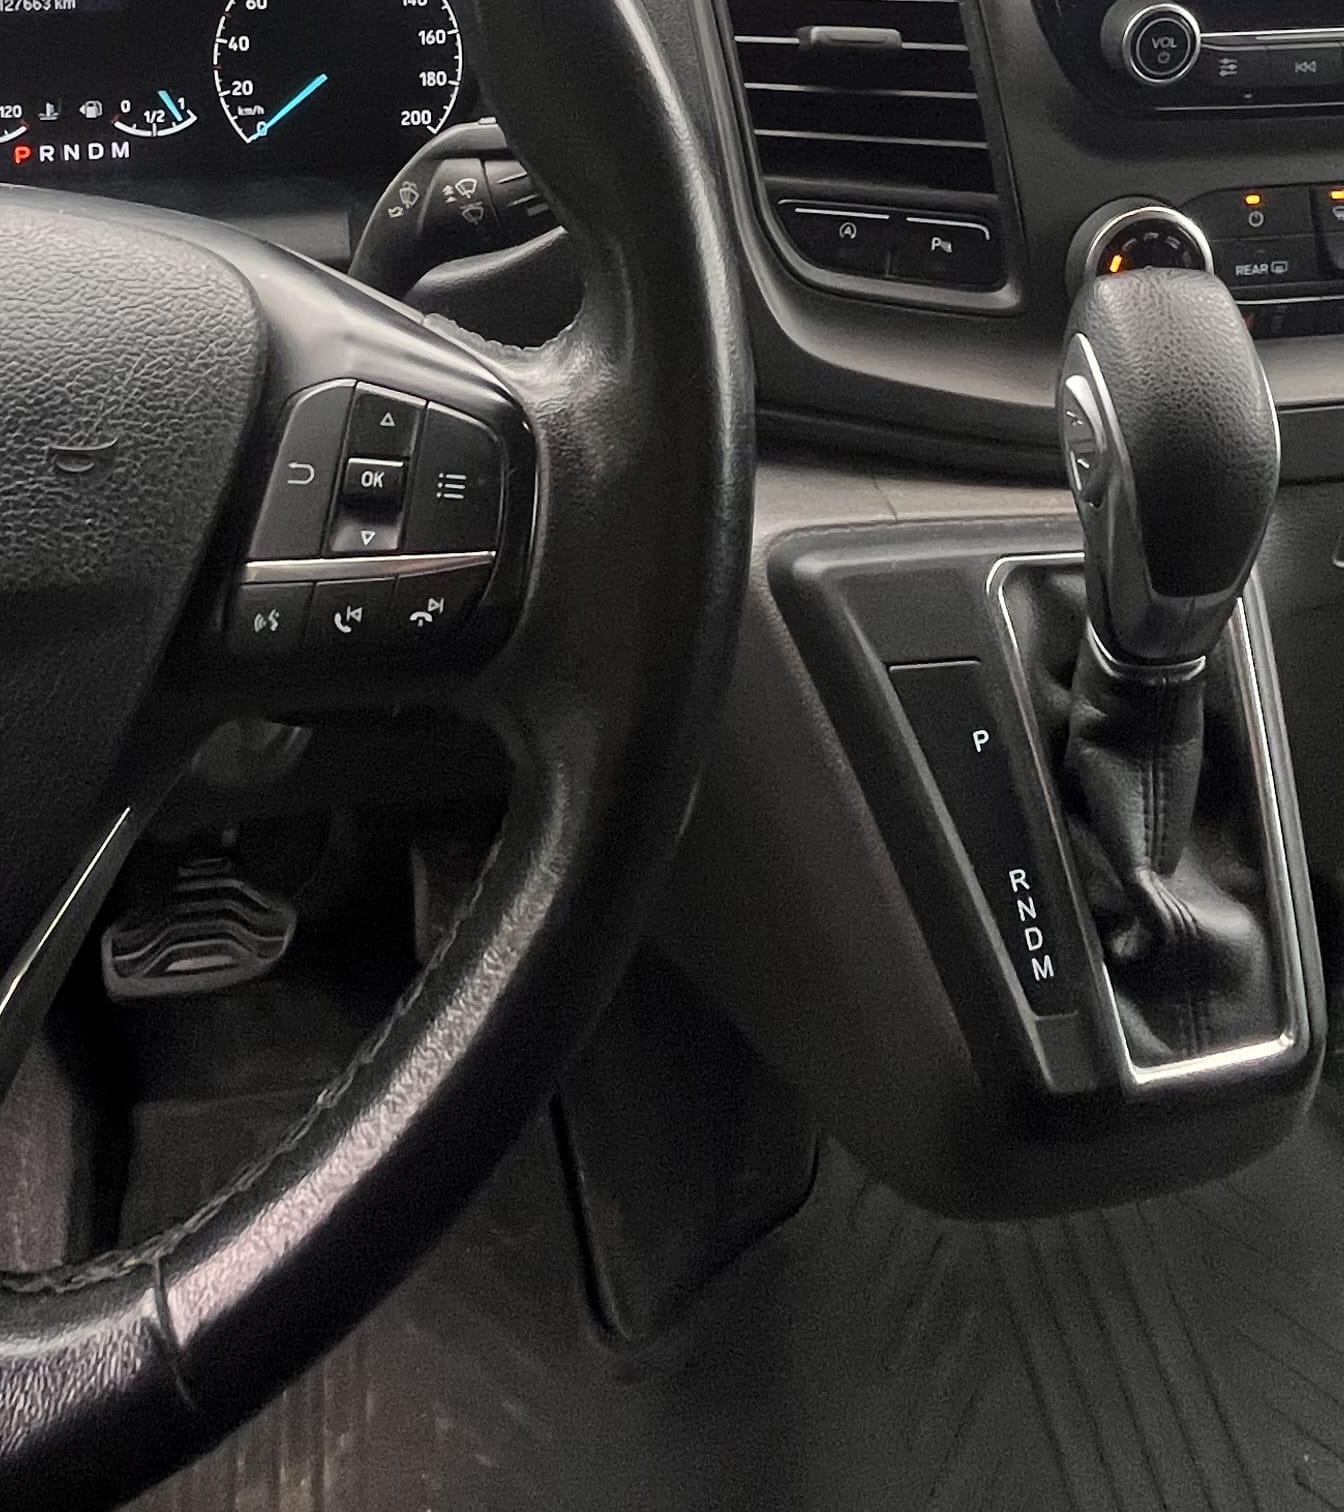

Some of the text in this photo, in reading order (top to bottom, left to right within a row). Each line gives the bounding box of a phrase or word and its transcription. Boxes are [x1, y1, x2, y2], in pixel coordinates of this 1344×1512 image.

[228, 36, 250, 52] 40
[418, 29, 446, 45] 160
[1150, 35, 1177, 50] VOL
[419, 71, 447, 87] 180
[231, 81, 254, 96] 20
[121, 99, 131, 113] 0
[177, 97, 185, 110] 1
[237, 105, 265, 116] km/h
[144, 110, 166, 124] 1/2
[400, 110, 432, 126] 200
[256, 121, 268, 137] 0
[14, 141, 130, 164] P R N D M
[1235, 263, 1269, 276] REAR
[360, 471, 385, 488] OK
[972, 730, 990, 752] P
[1008, 869, 1030, 891] R
[1016, 898, 1037, 922] N
[1025, 927, 1043, 951] D
[1031, 955, 1054, 981] M
